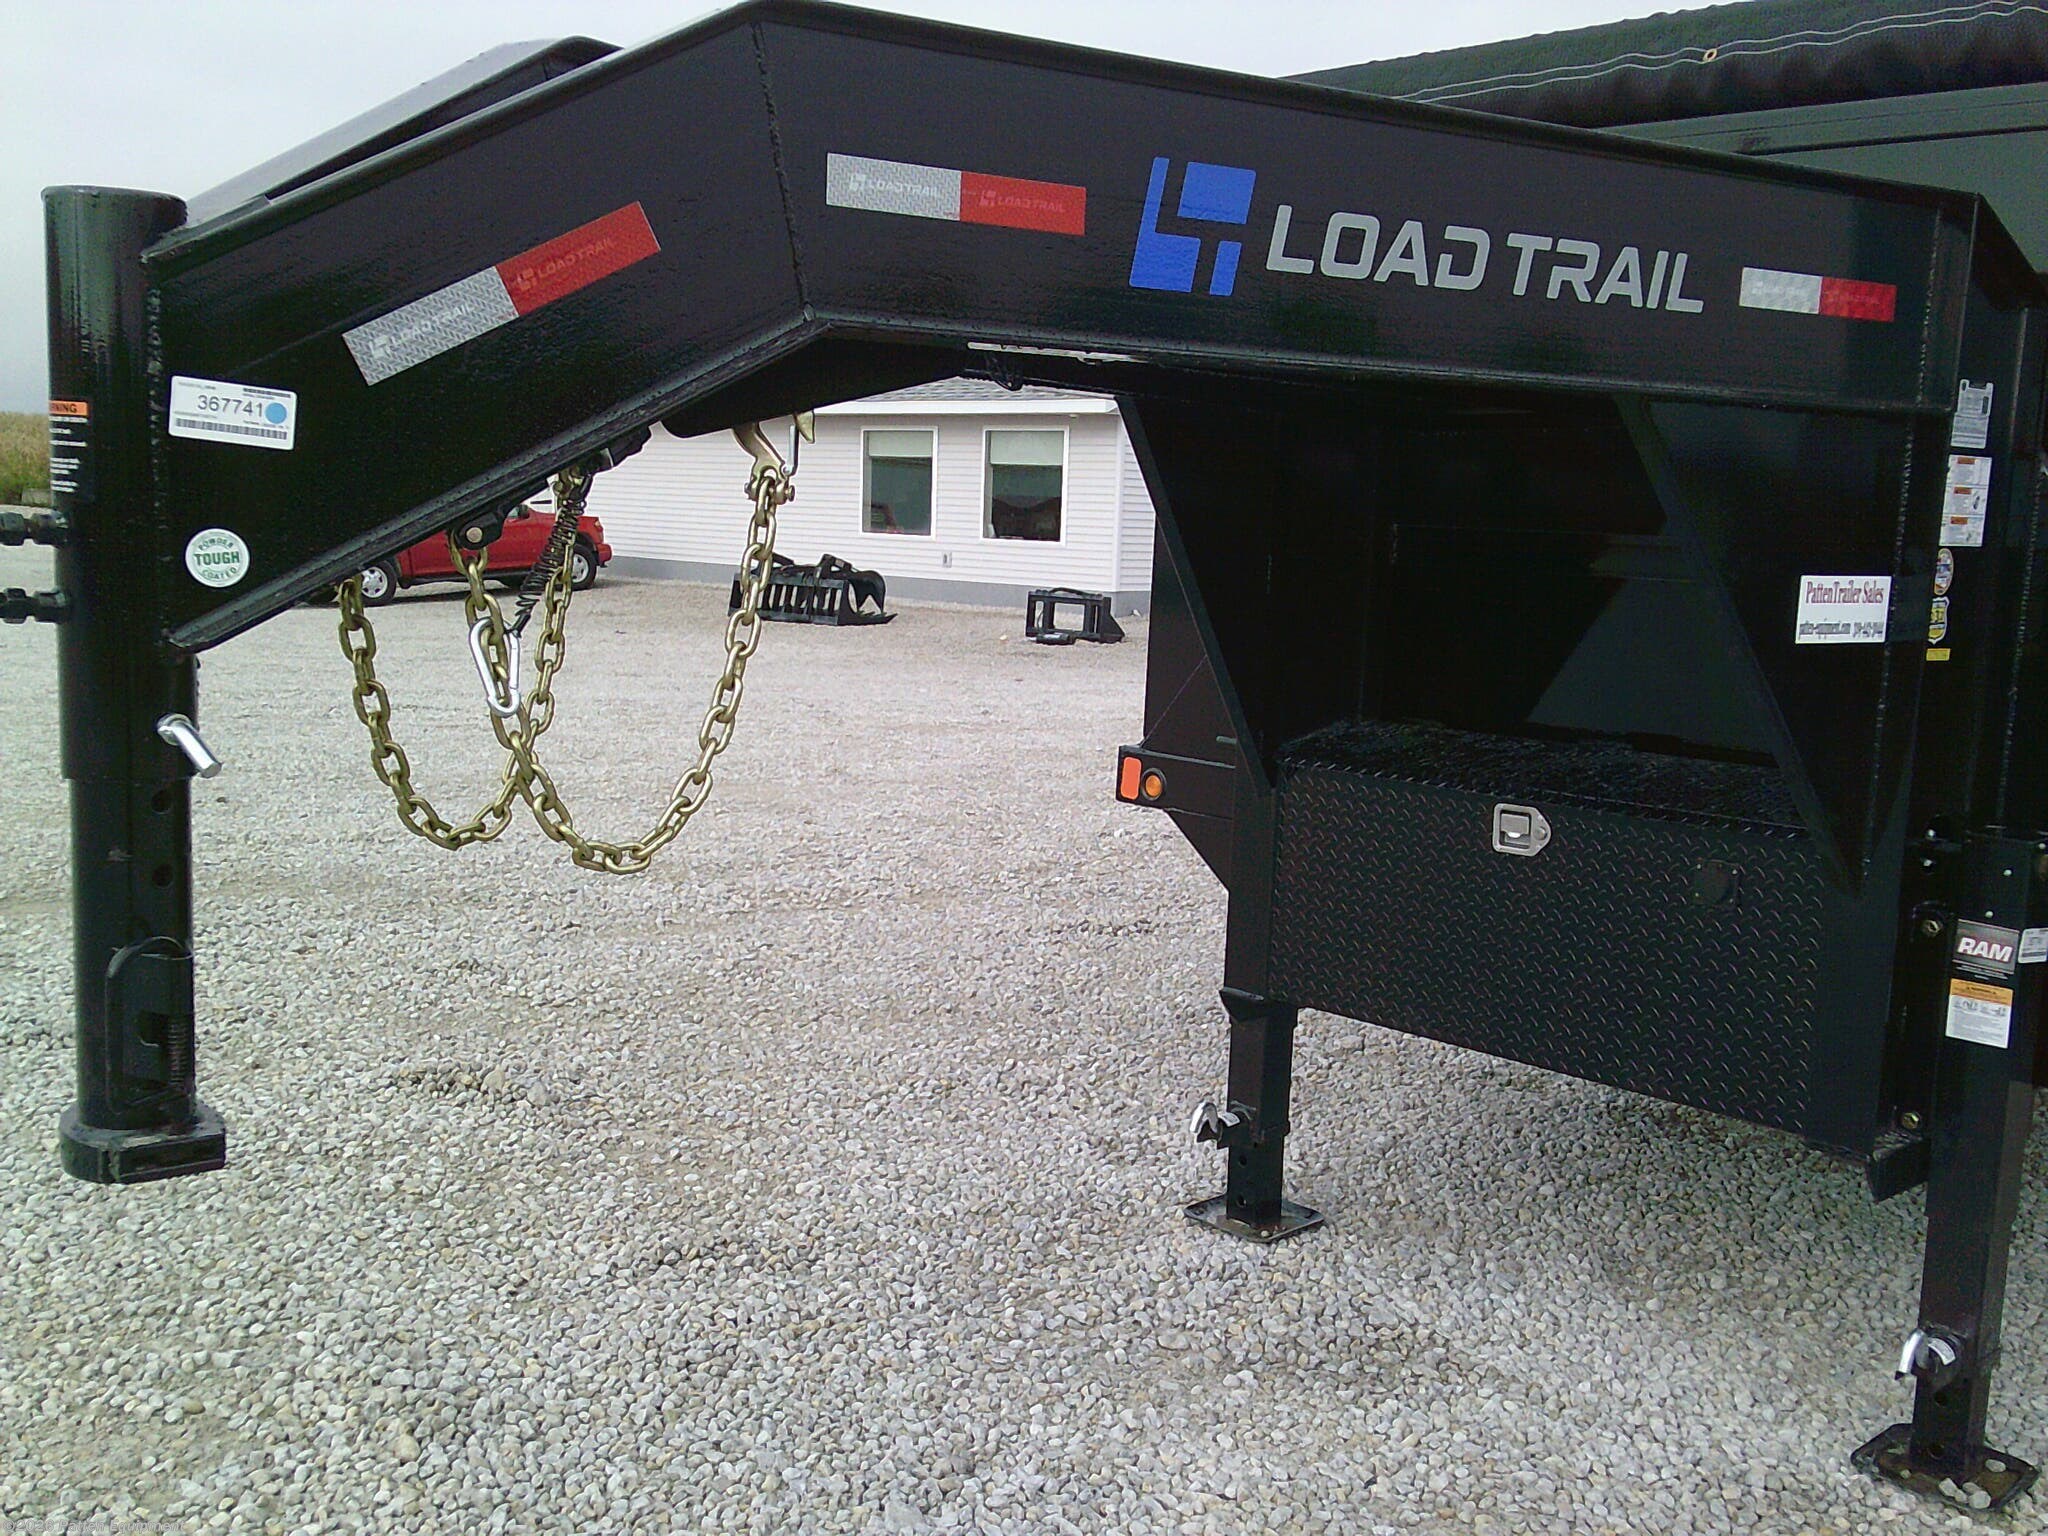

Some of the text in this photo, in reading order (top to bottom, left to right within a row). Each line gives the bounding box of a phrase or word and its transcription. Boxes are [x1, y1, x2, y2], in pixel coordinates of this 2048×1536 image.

[1266, 205, 1705, 314] LOAD TRAIL
[197, 394, 264, 418] 367741
[198, 537, 234, 551] POWDER
[193, 551, 240, 566] TOUGH
[202, 566, 237, 580] COATED
[1806, 580, 1884, 604] Patten Trailer Sales
[1956, 937, 2013, 962] RAM
